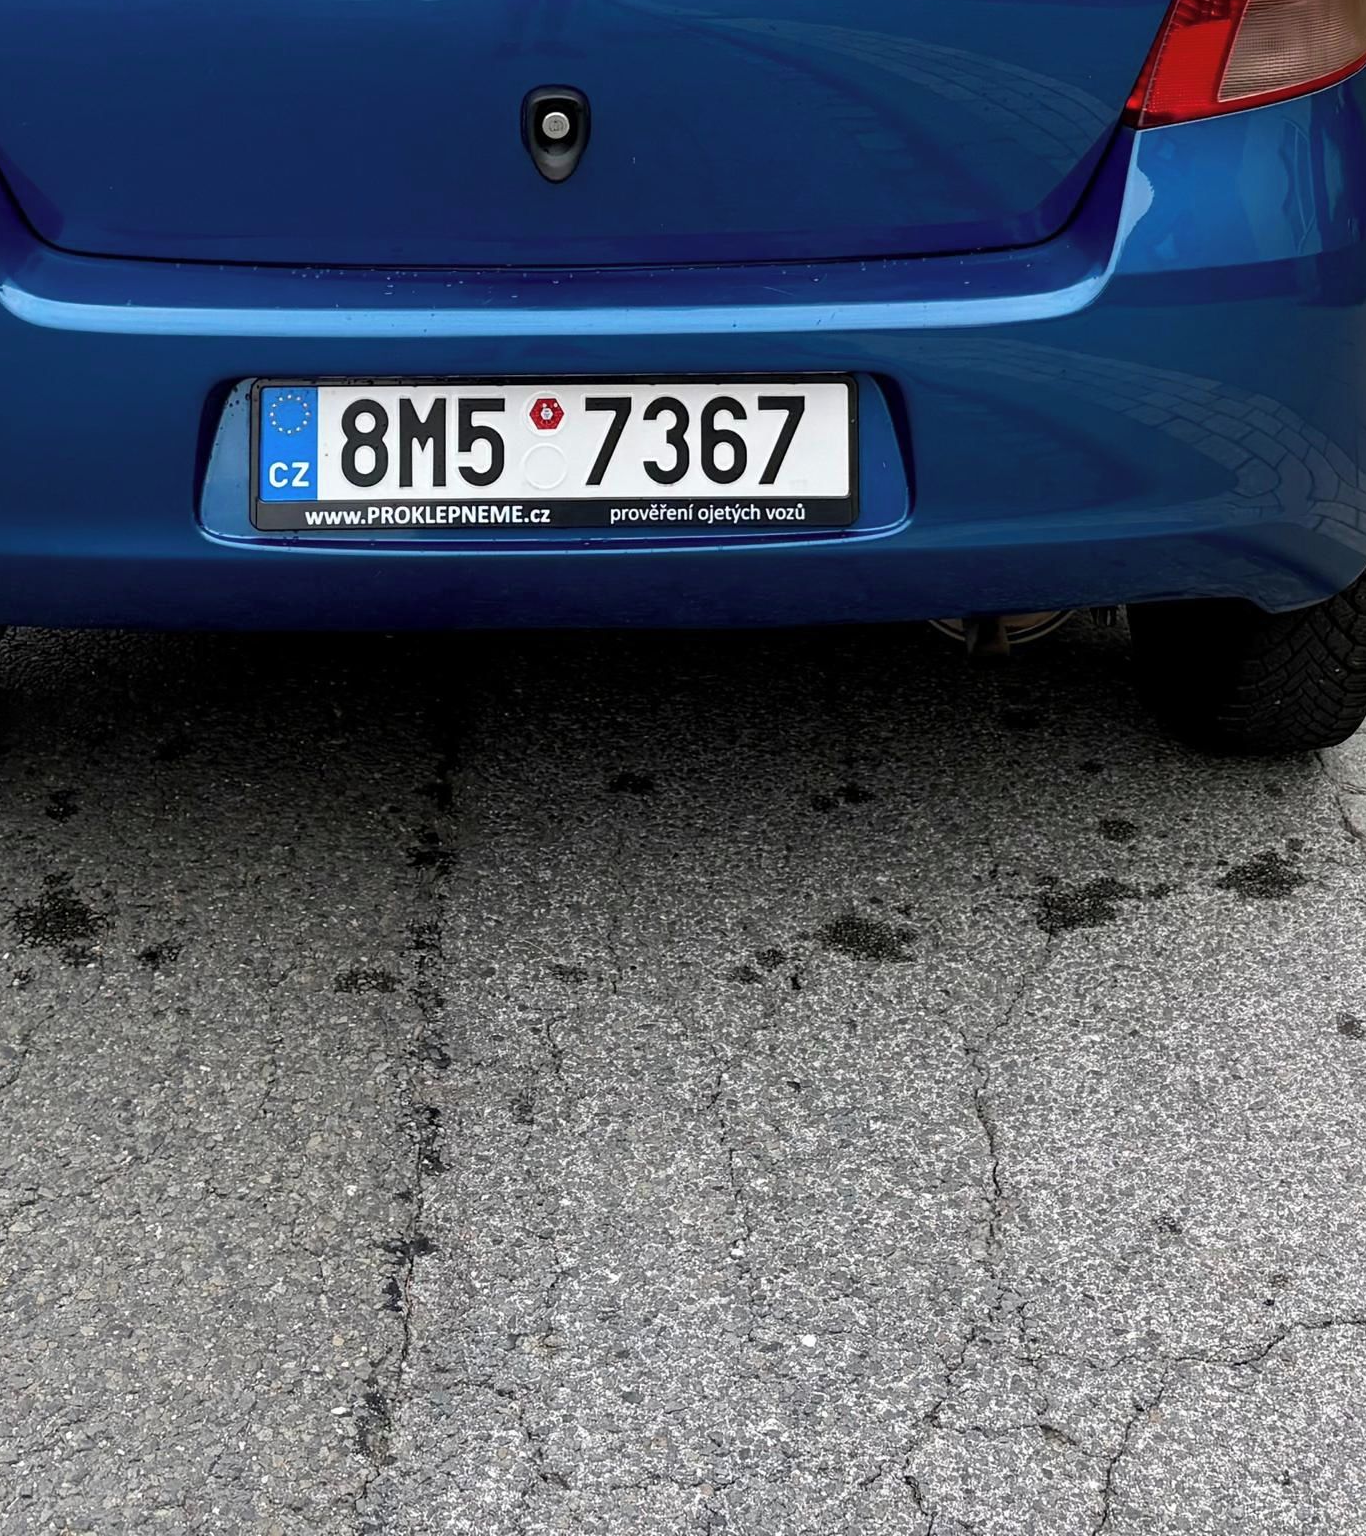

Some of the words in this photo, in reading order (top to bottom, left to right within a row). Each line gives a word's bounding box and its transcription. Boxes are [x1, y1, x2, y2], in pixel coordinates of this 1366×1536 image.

[341, 397, 505, 488] 8M5
[585, 395, 805, 486] 7367
[269, 461, 310, 488] CZ
[305, 505, 551, 525] www.PROKLEPNEME.cz
[610, 504, 694, 525] prověření
[697, 503, 761, 524] ojetých
[765, 503, 806, 521] vozů
